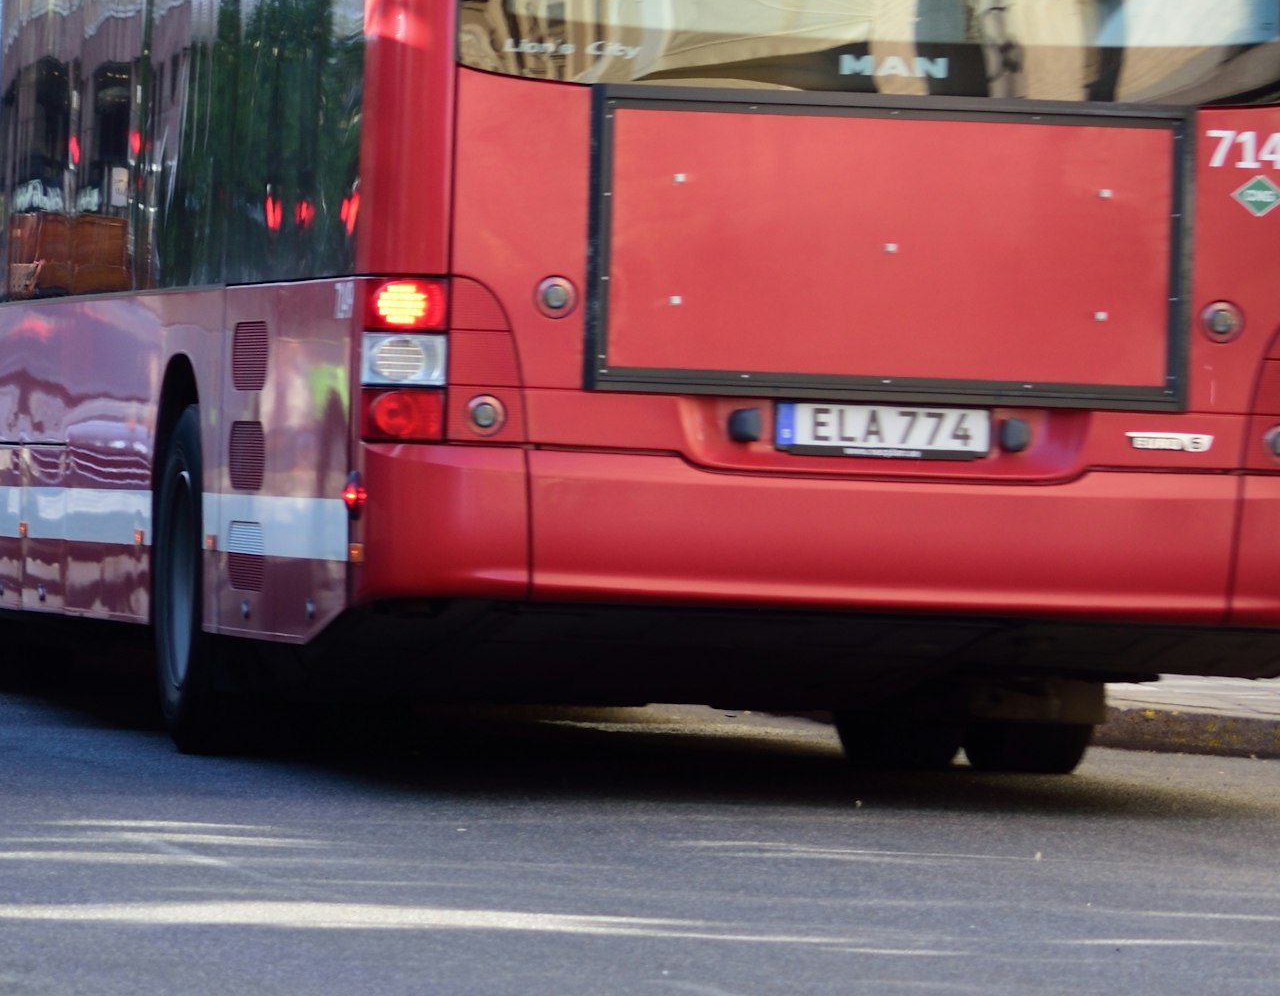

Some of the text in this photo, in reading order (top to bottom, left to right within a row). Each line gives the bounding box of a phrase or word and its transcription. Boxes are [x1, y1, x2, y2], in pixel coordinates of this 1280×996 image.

[838, 54, 949, 79] MAN
[812, 407, 973, 447] ELA 774
